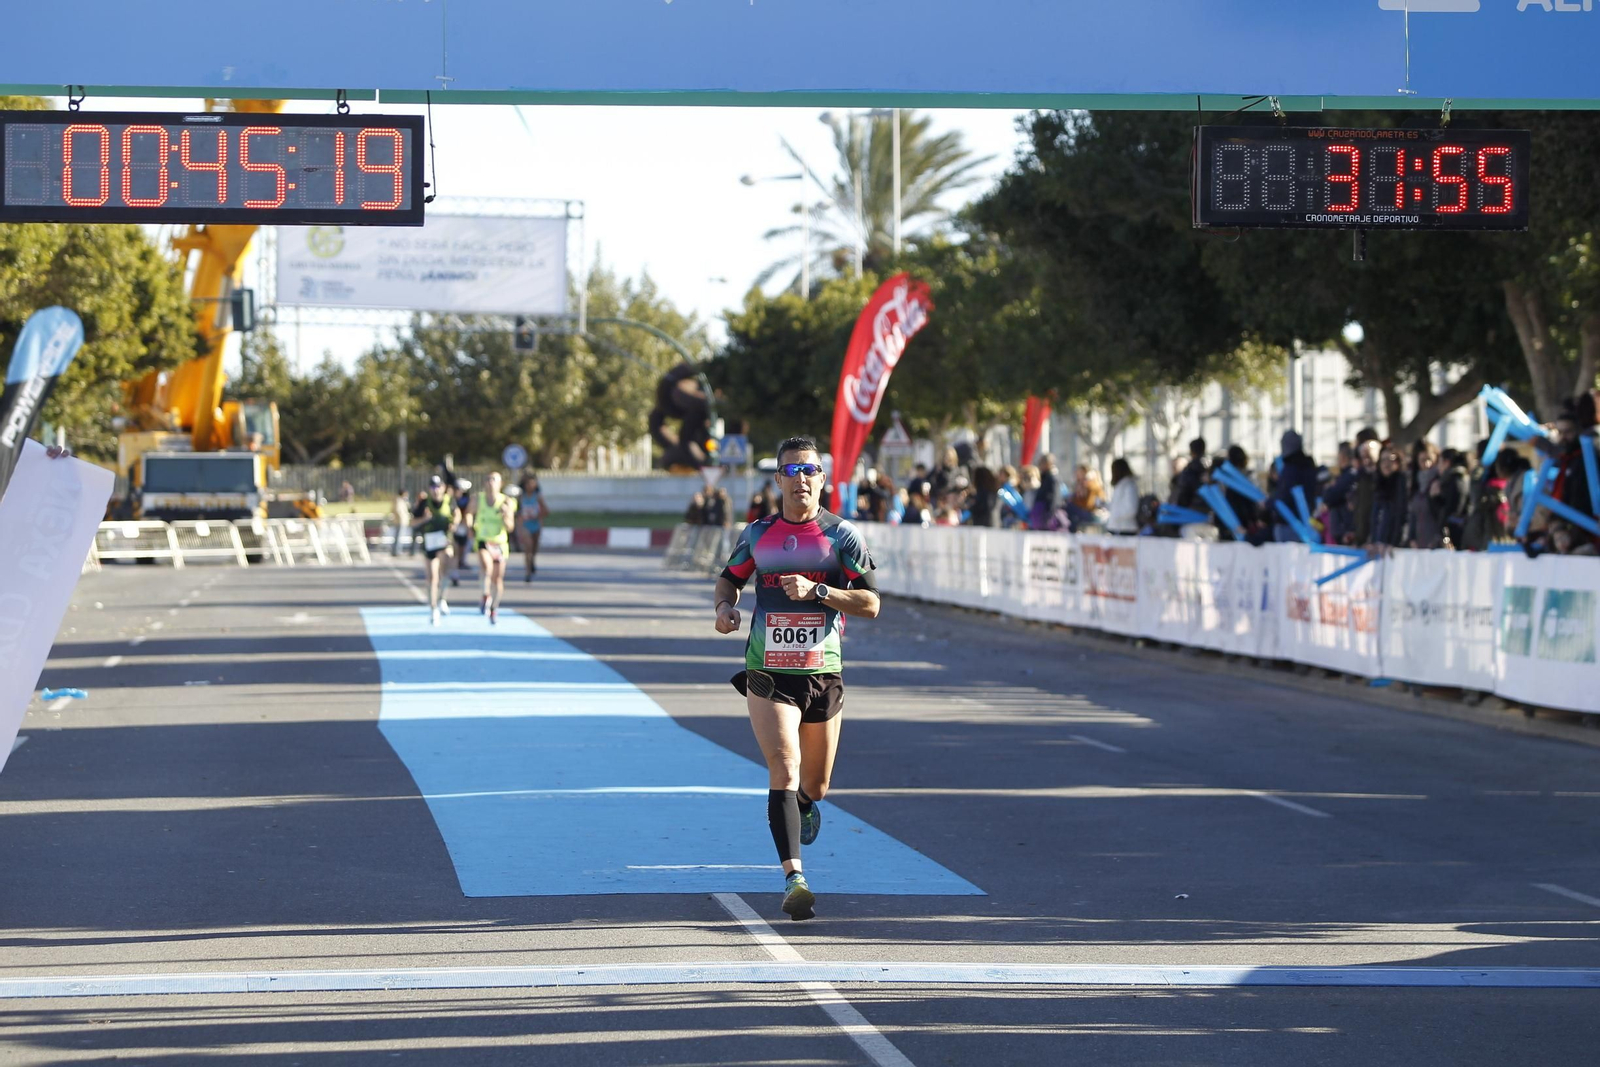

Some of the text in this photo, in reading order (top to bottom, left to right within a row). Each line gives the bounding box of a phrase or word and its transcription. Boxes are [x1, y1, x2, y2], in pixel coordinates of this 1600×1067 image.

[63, 124, 403, 210] 00:45:19
[1327, 145, 1513, 213] 31:55
[1305, 214, 1419, 223] CRONOMETRAJE DEPORTIVO
[1, 321, 78, 449] POWERADE
[772, 627, 818, 644] 6061
